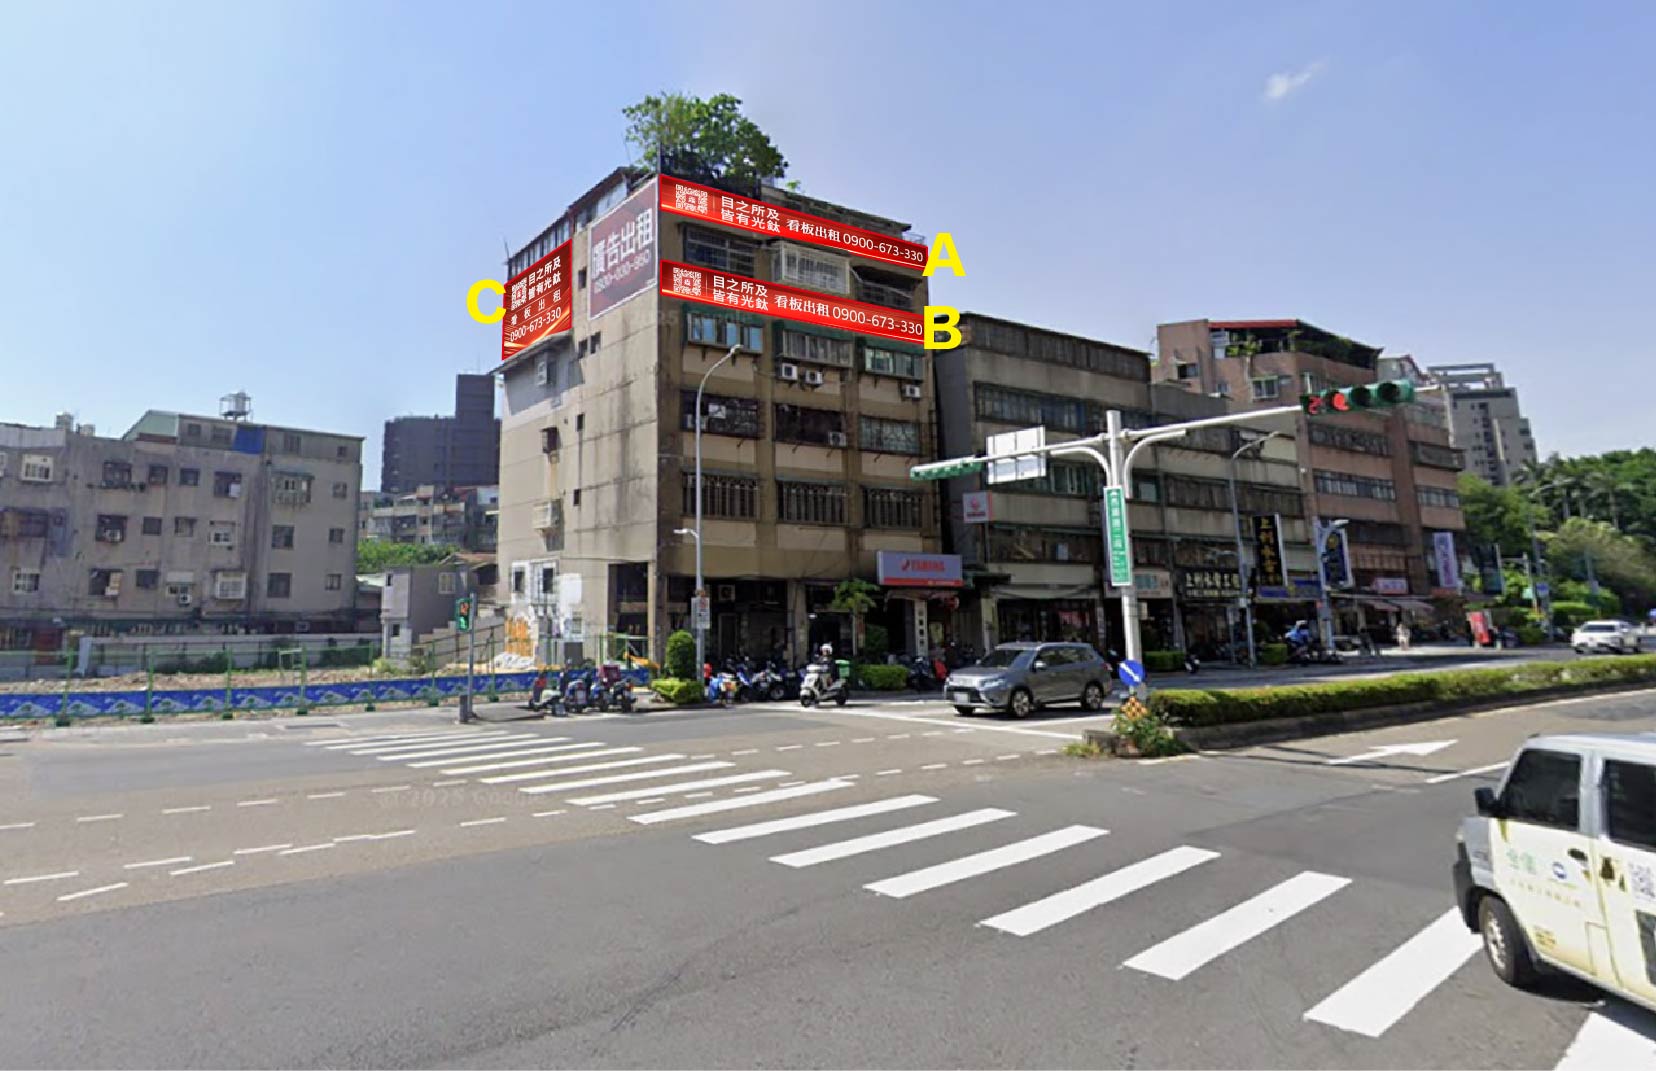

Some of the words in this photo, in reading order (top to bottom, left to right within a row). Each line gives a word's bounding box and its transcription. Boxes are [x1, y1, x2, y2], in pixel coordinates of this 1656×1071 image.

[721, 196, 780, 222] 目之所及
[721, 209, 780, 233] 皆有光鈦
[786, 220, 840, 243] 看板出租
[843, 233, 924, 262] 0900-673-330
[529, 256, 561, 286] 目之所及
[713, 289, 768, 311] 皆有光鈦
[714, 275, 768, 298] 目之所及
[510, 307, 561, 342] 0900-673-330
[775, 295, 830, 317] 看板出租
[833, 306, 923, 336] 0900-673-330
